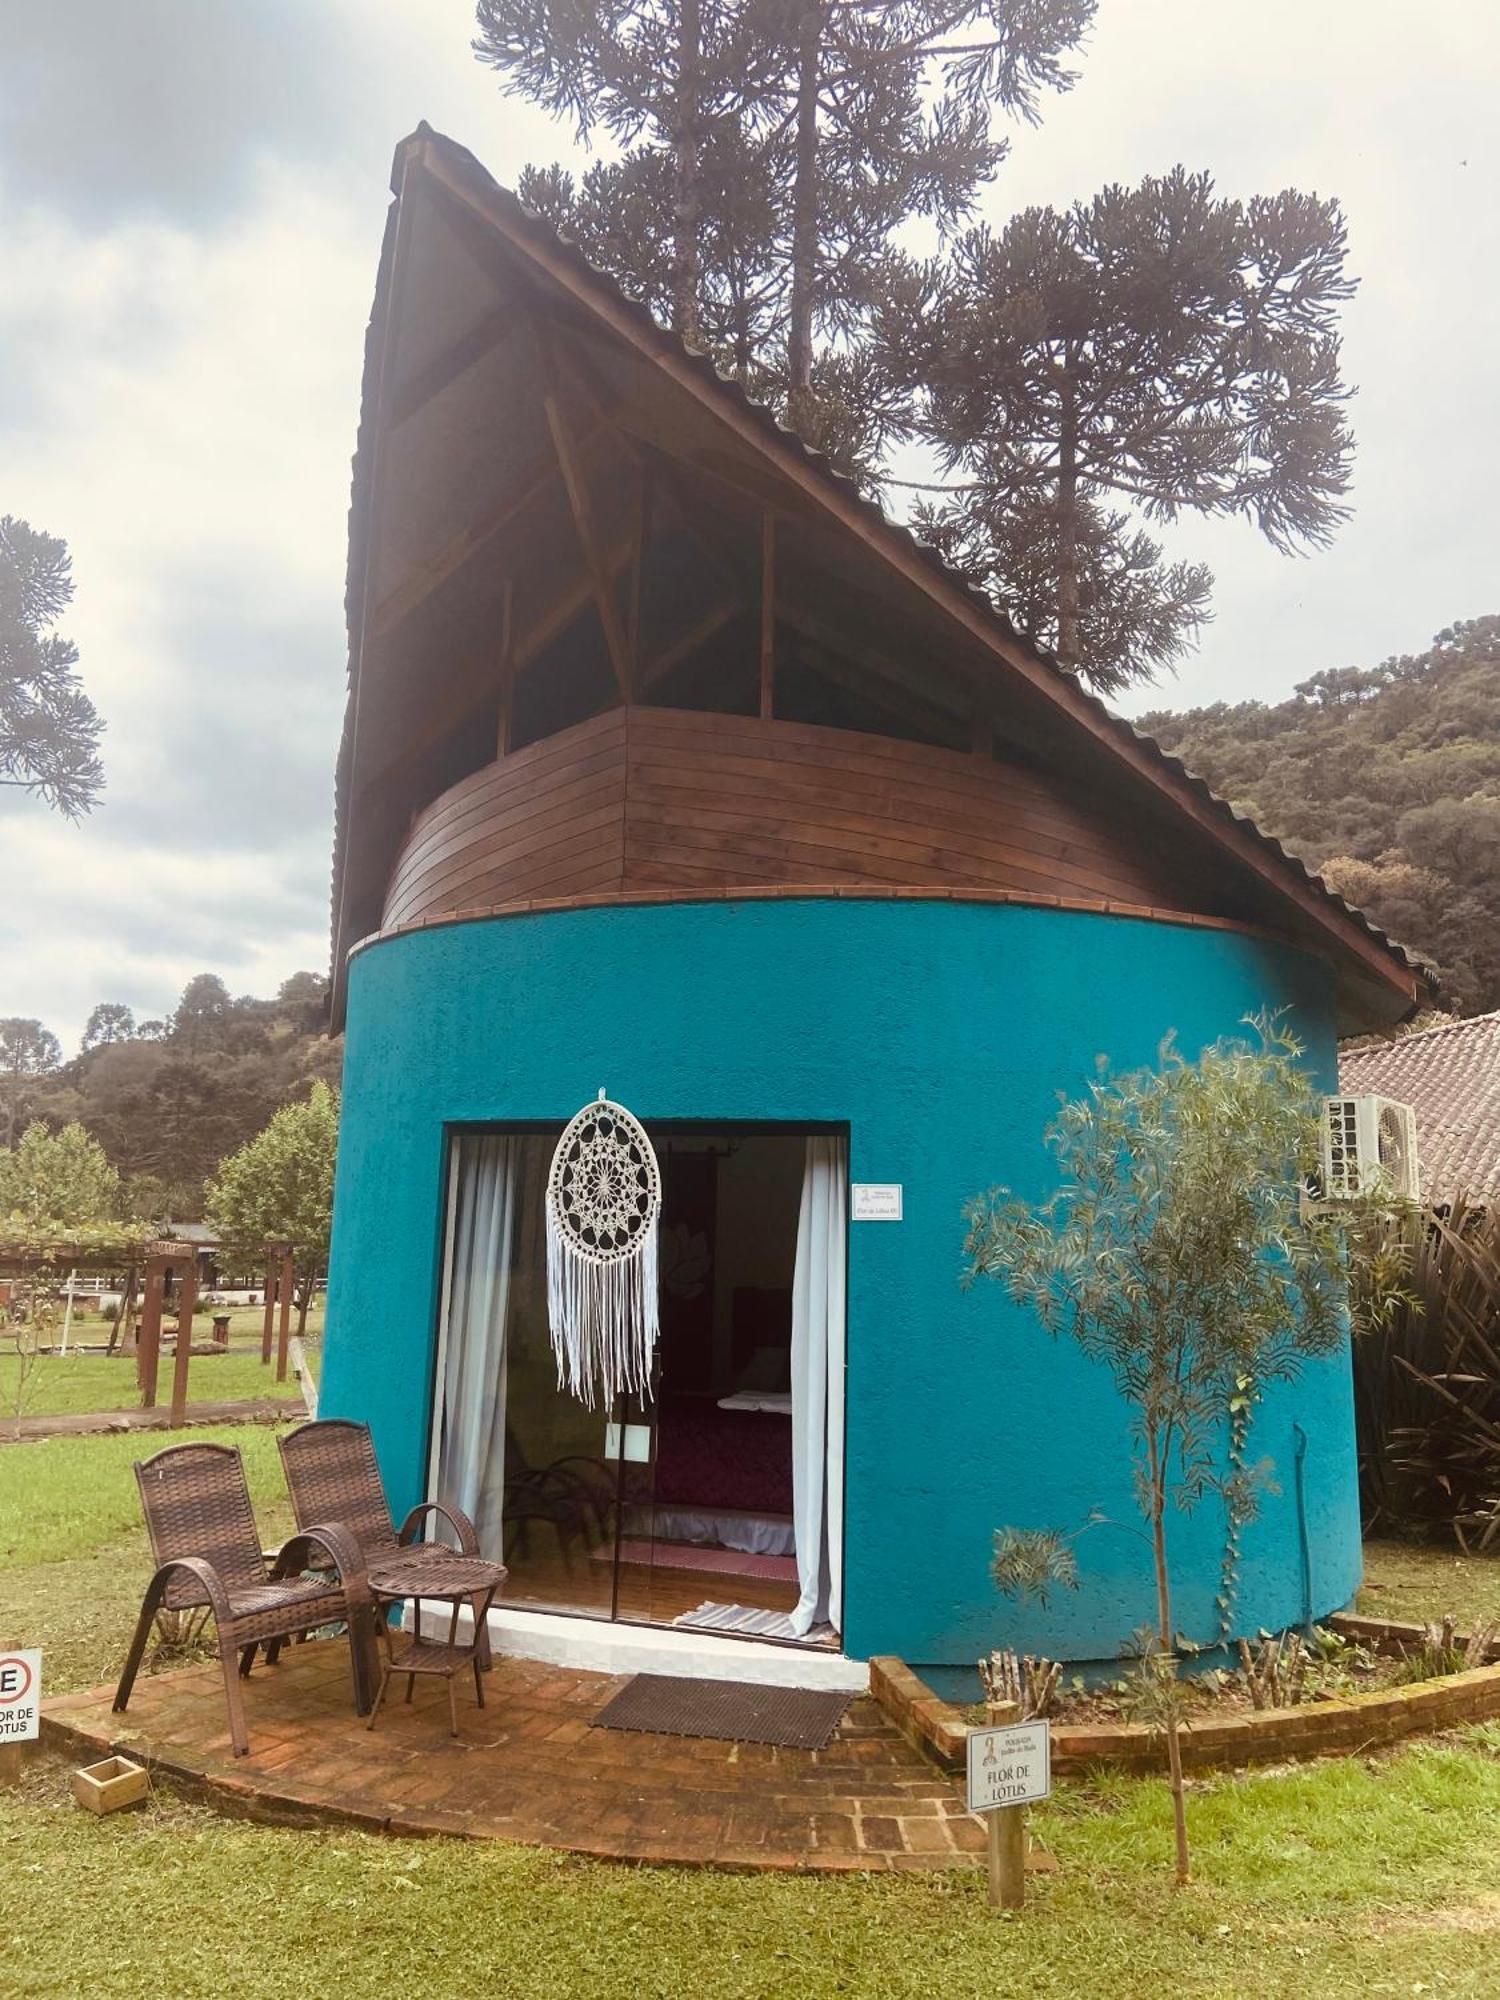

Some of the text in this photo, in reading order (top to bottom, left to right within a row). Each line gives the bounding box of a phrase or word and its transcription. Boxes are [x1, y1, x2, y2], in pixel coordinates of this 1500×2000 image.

[1, 1669, 17, 1692] E
[18, 1707, 33, 1720] DE
[988, 1765, 1031, 1784] FLOR DE
